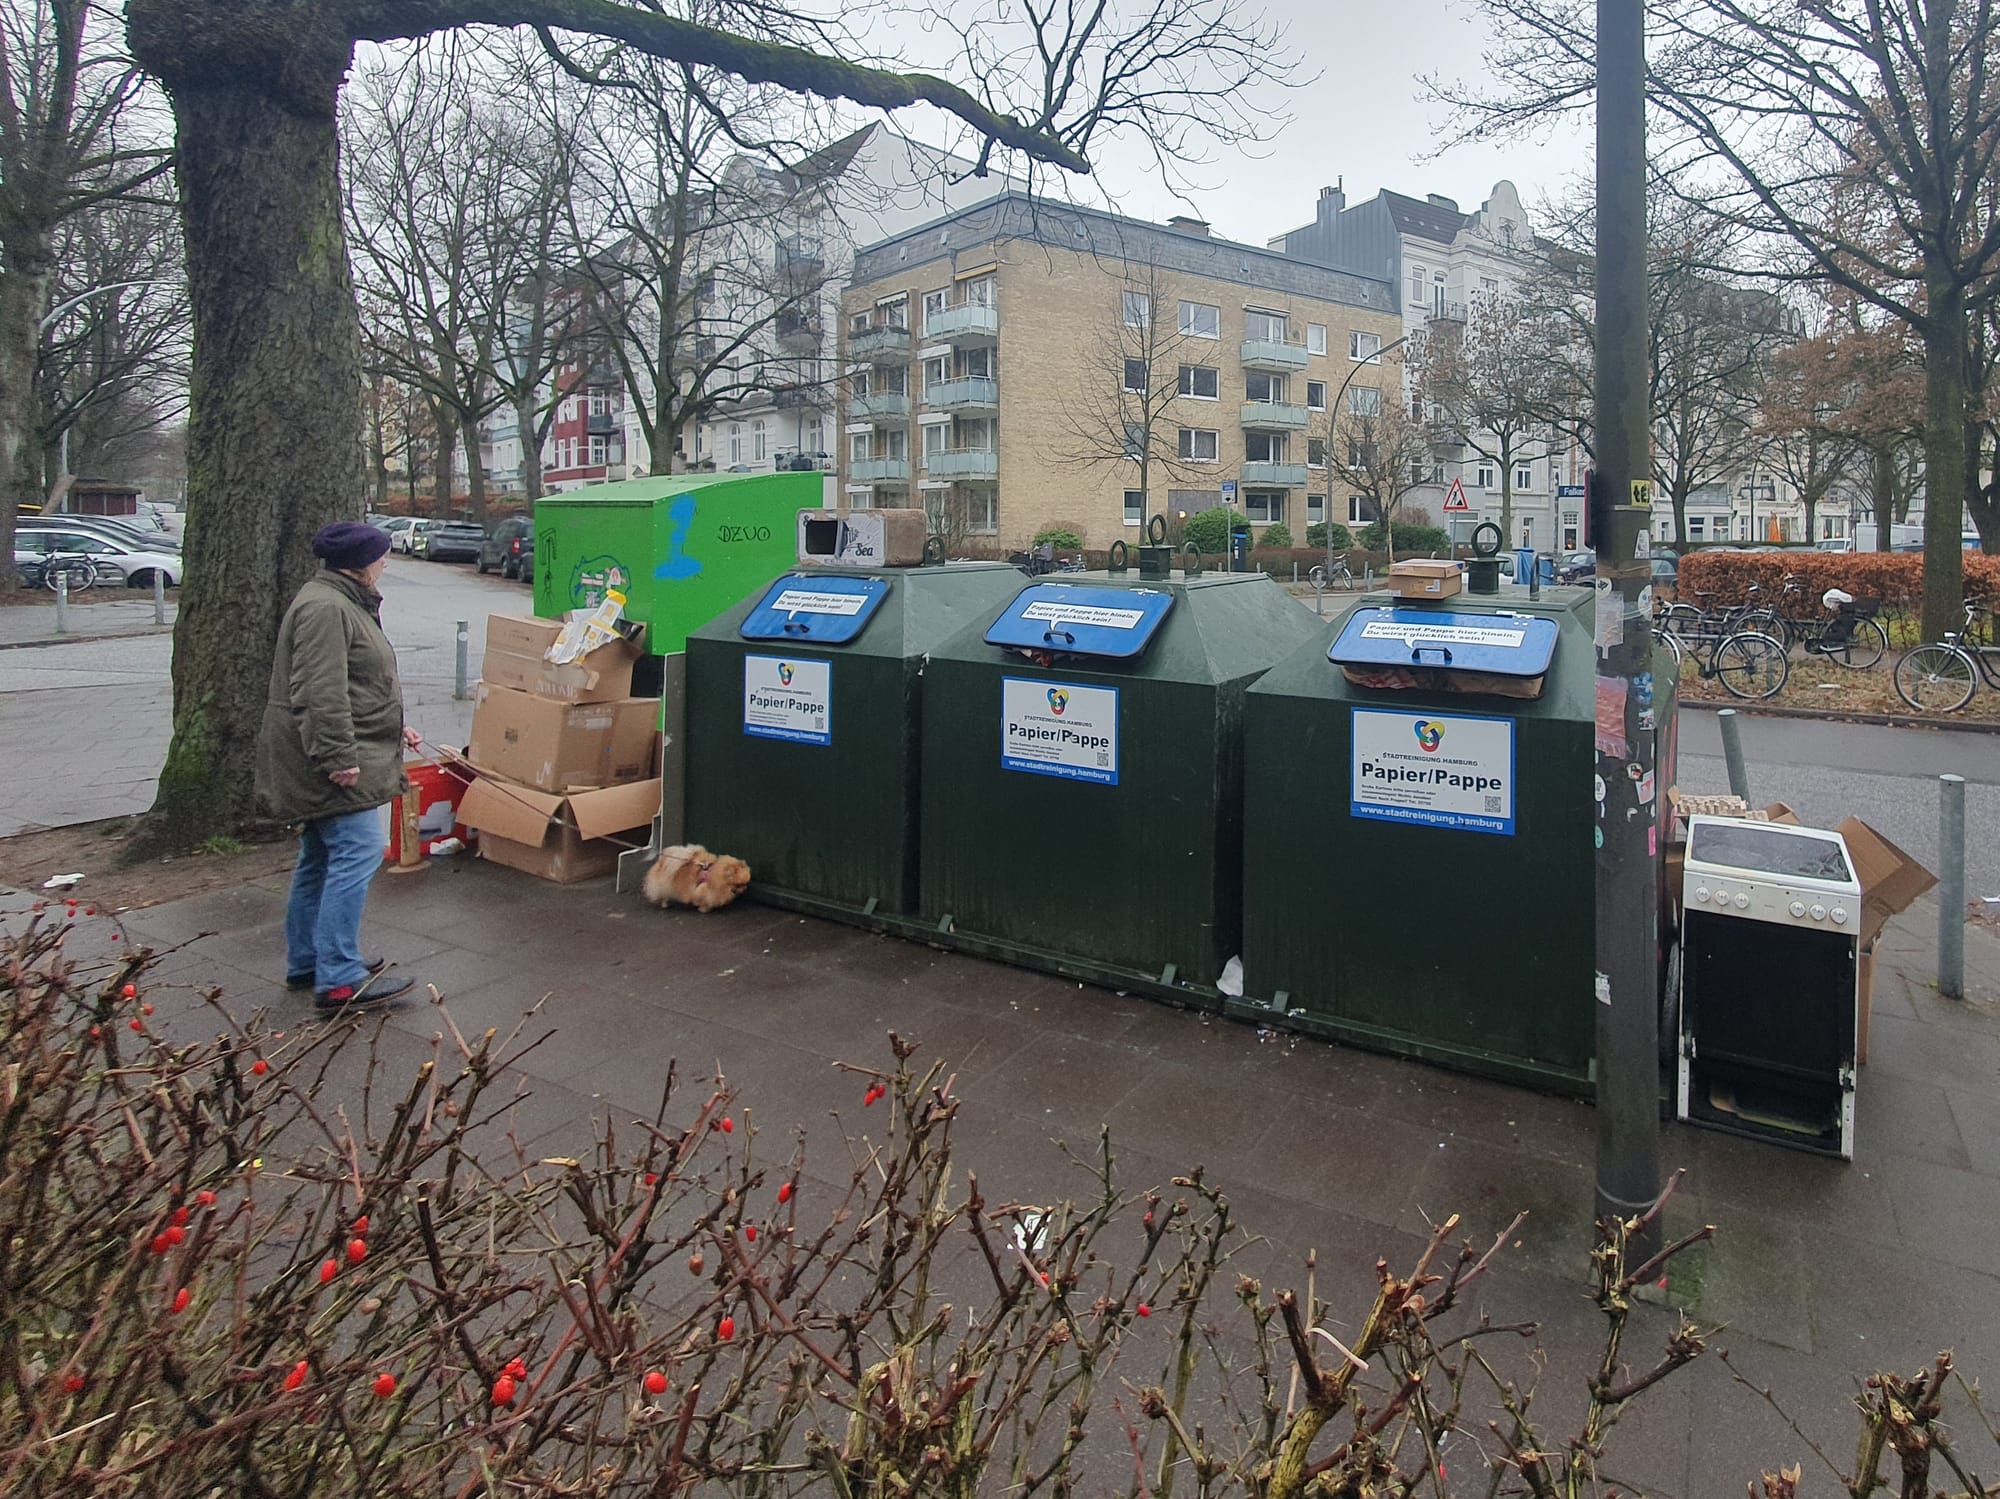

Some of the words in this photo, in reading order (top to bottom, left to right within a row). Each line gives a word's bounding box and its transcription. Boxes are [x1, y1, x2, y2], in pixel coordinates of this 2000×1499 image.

[855, 543, 873, 556] Sea
[1057, 612, 1090, 621] glücklich
[1409, 631, 1456, 640] glücklich
[1481, 630, 1516, 638] hinein.
[750, 694, 824, 714] Papier/Pappe
[1009, 723, 1109, 749] Papier/Pappe
[1382, 752, 1441, 763] STADTREINIGUNG
[1443, 758, 1478, 766] HAMBURG
[1008, 760, 1111, 781] www.stadtreinigung.hamburg
[1361, 762, 1502, 792] Papier/Pappe
[1360, 805, 1503, 830] www.stadtreinigung.hamburg
